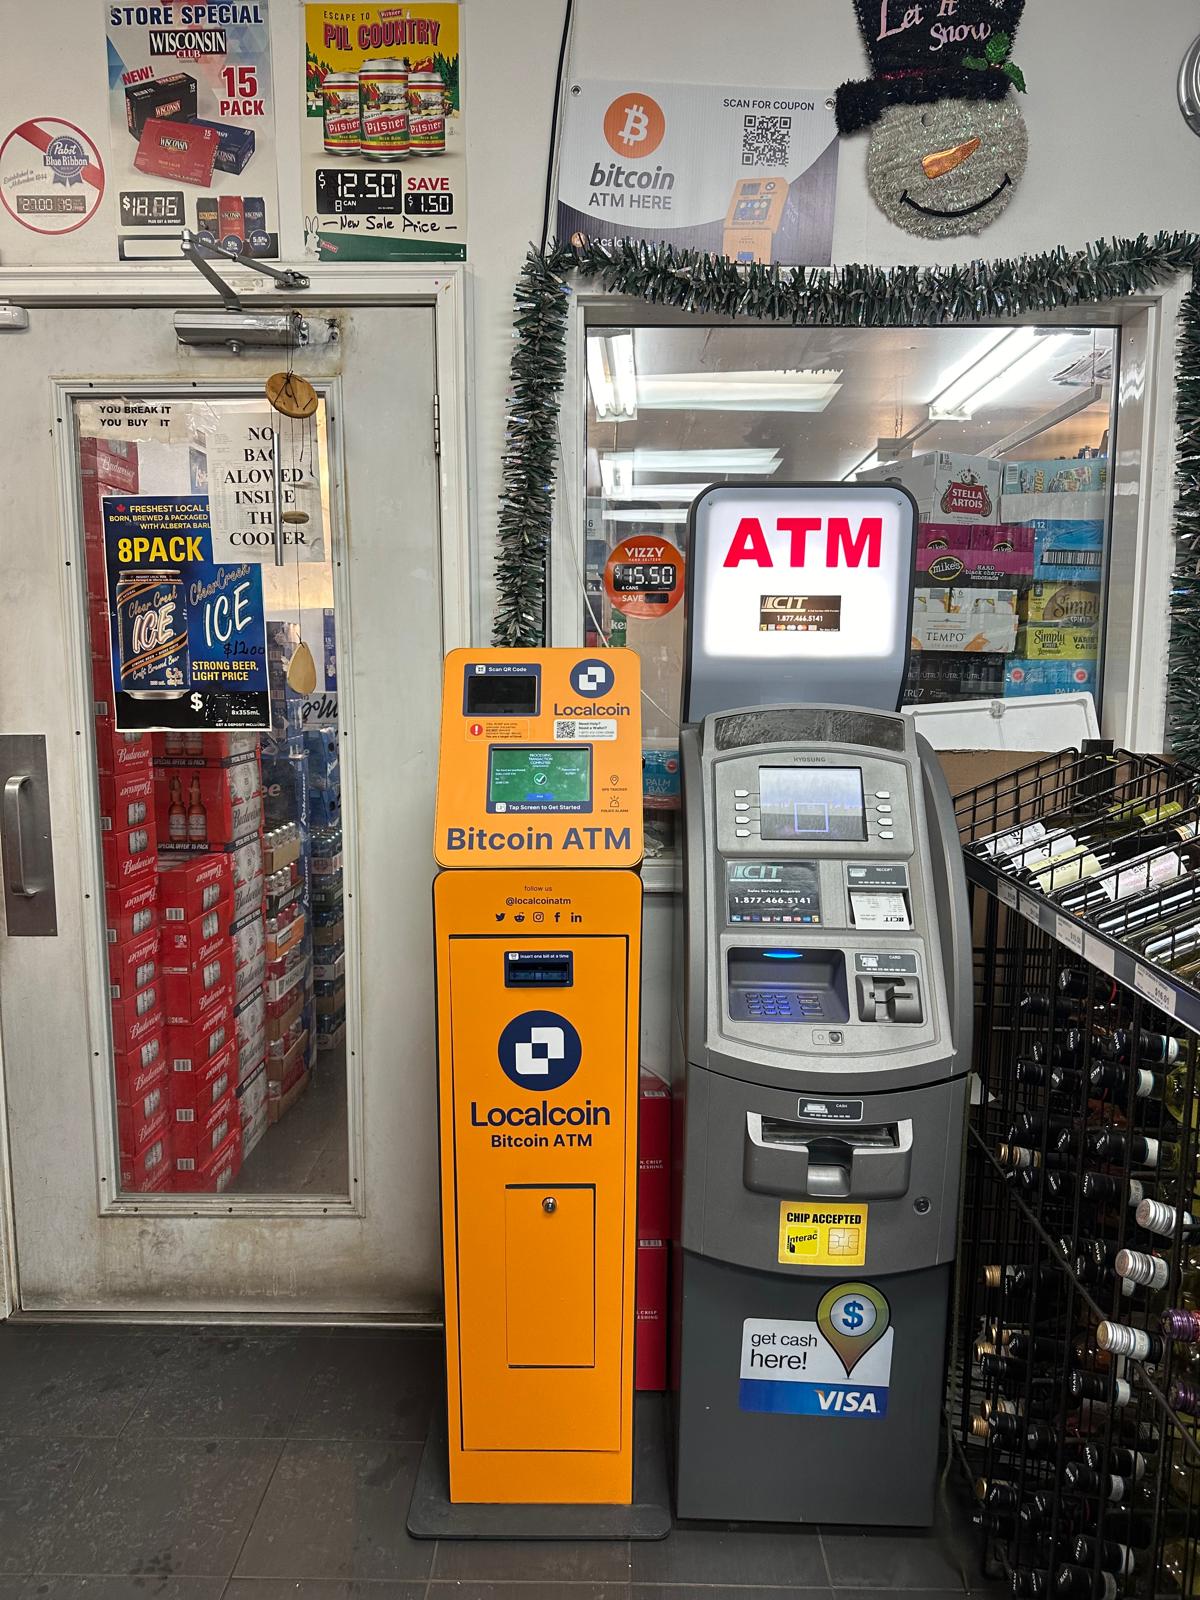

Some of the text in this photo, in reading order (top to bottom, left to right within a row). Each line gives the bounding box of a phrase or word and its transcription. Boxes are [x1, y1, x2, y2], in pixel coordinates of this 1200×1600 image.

[110, 5, 264, 26] STORE SPECIAL
[323, 10, 370, 21] ESCAPE TO
[876, 0, 924, 41] Let
[323, 19, 440, 50] PIL COUNTRY
[929, 22, 991, 51] Snow
[150, 30, 226, 54] WISCONSIN
[176, 50, 201, 59] CLUB
[122, 65, 155, 86] NEW!
[222, 67, 258, 98] 15
[220, 100, 265, 116] PACK
[723, 99, 815, 111] SCAN FOR COUPON
[329, 121, 360, 134] Pilsner
[366, 118, 405, 134] Pilsner
[410, 121, 441, 134] Pilsner
[54, 141, 77, 155] Pabst
[45, 155, 88, 166] Blue Ribbon
[590, 162, 675, 190] bitcoin
[407, 177, 449, 191] SAVE
[335, 200, 342, 212] 8
[589, 192, 672, 210] ATM HERE
[340, 215, 440, 233] New Sale Price
[99, 406, 172, 414] YOU BREAK IT
[100, 419, 170, 427] YOU BUY IT
[248, 427, 275, 441] NO
[235, 490, 296, 504] INSIE
[952, 488, 983, 500] STELLA
[129, 505, 173, 513] FRESHEST
[175, 504, 204, 512] LOCAL
[951, 499, 983, 509] ARTOIS
[109, 515, 132, 523] BORN,
[171, 513, 208, 521] PACKAGED
[247, 511, 284, 525] TH
[588, 520, 594, 528] 6
[1037, 521, 1046, 529] 12
[160, 522, 192, 530] ALBERTA
[118, 536, 205, 563] 8PACK
[723, 517, 883, 568] ATM
[624, 546, 665, 558] VIZZY
[932, 558, 961, 573] mike's
[189, 579, 217, 606] Clear
[622, 594, 644, 602] SAVE
[128, 600, 152, 618] Clear
[205, 581, 253, 647] ICE
[132, 601, 176, 654] ICE
[926, 631, 964, 642] TEMPO
[1034, 630, 1065, 647] Simply
[192, 660, 259, 672] STRONG BEER,
[192, 671, 249, 681] LIGHT PRICE
[190, 691, 204, 712] $
[554, 703, 631, 716] Localcoin
[117, 747, 149, 763] Budweiser
[447, 826, 631, 850] Bitcoin ATM
[123, 855, 155, 875] Budweiser
[505, 897, 571, 906] @localcoinatm
[734, 896, 811, 904] 1.877.466.5141
[129, 1012, 162, 1040] Budweiser
[471, 1099, 611, 1127] Localcoin
[491, 1134, 592, 1148] Bitcoin ATM
[786, 1212, 862, 1225] CHIP ACCEPTED
[787, 1232, 818, 1245] Interac
[842, 1300, 865, 1330] $
[751, 1333, 818, 1348] get cash
[750, 1349, 807, 1370] here!
[814, 1389, 877, 1413] VISA
